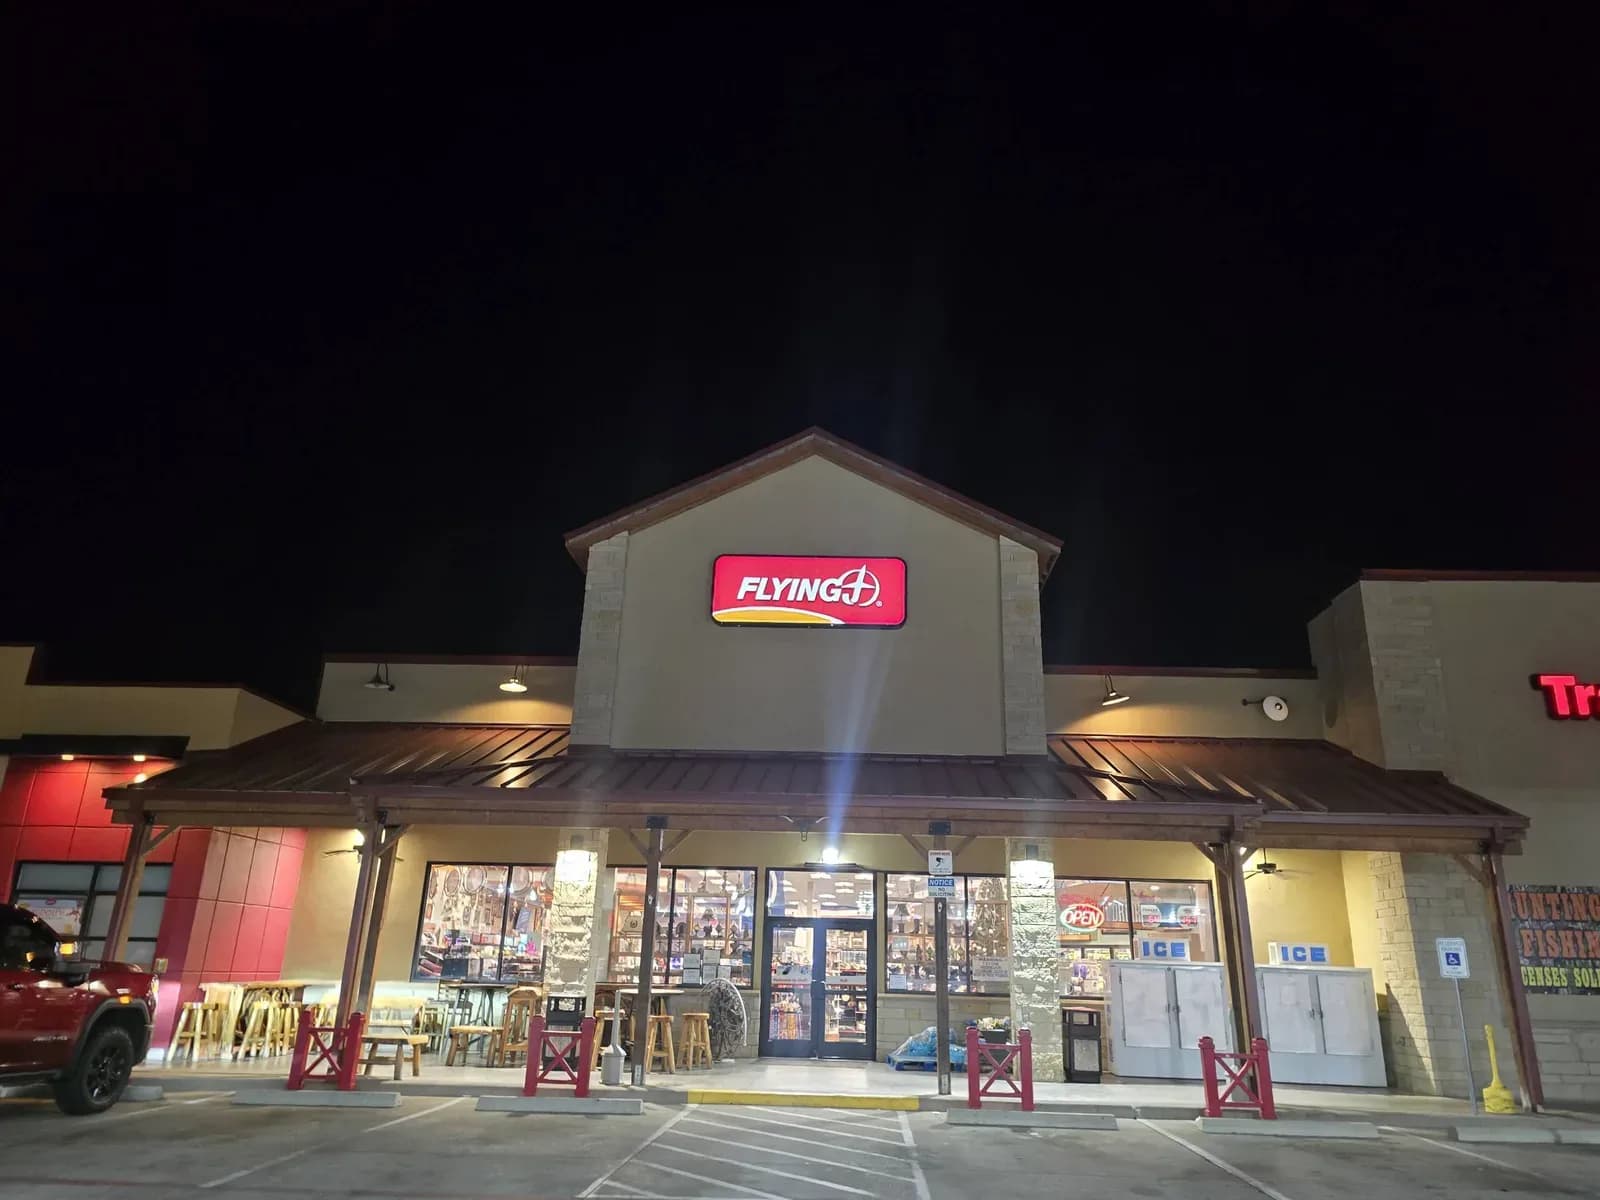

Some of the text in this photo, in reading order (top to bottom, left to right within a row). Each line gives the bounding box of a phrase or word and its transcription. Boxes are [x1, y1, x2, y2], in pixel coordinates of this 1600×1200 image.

[737, 576, 843, 603] FLYING
[1540, 675, 1600, 716] Tr
[1510, 892, 1600, 920] UNTING
[1064, 909, 1100, 926] OPEN
[1142, 941, 1186, 957] ICE
[1280, 946, 1326, 962] ICE
